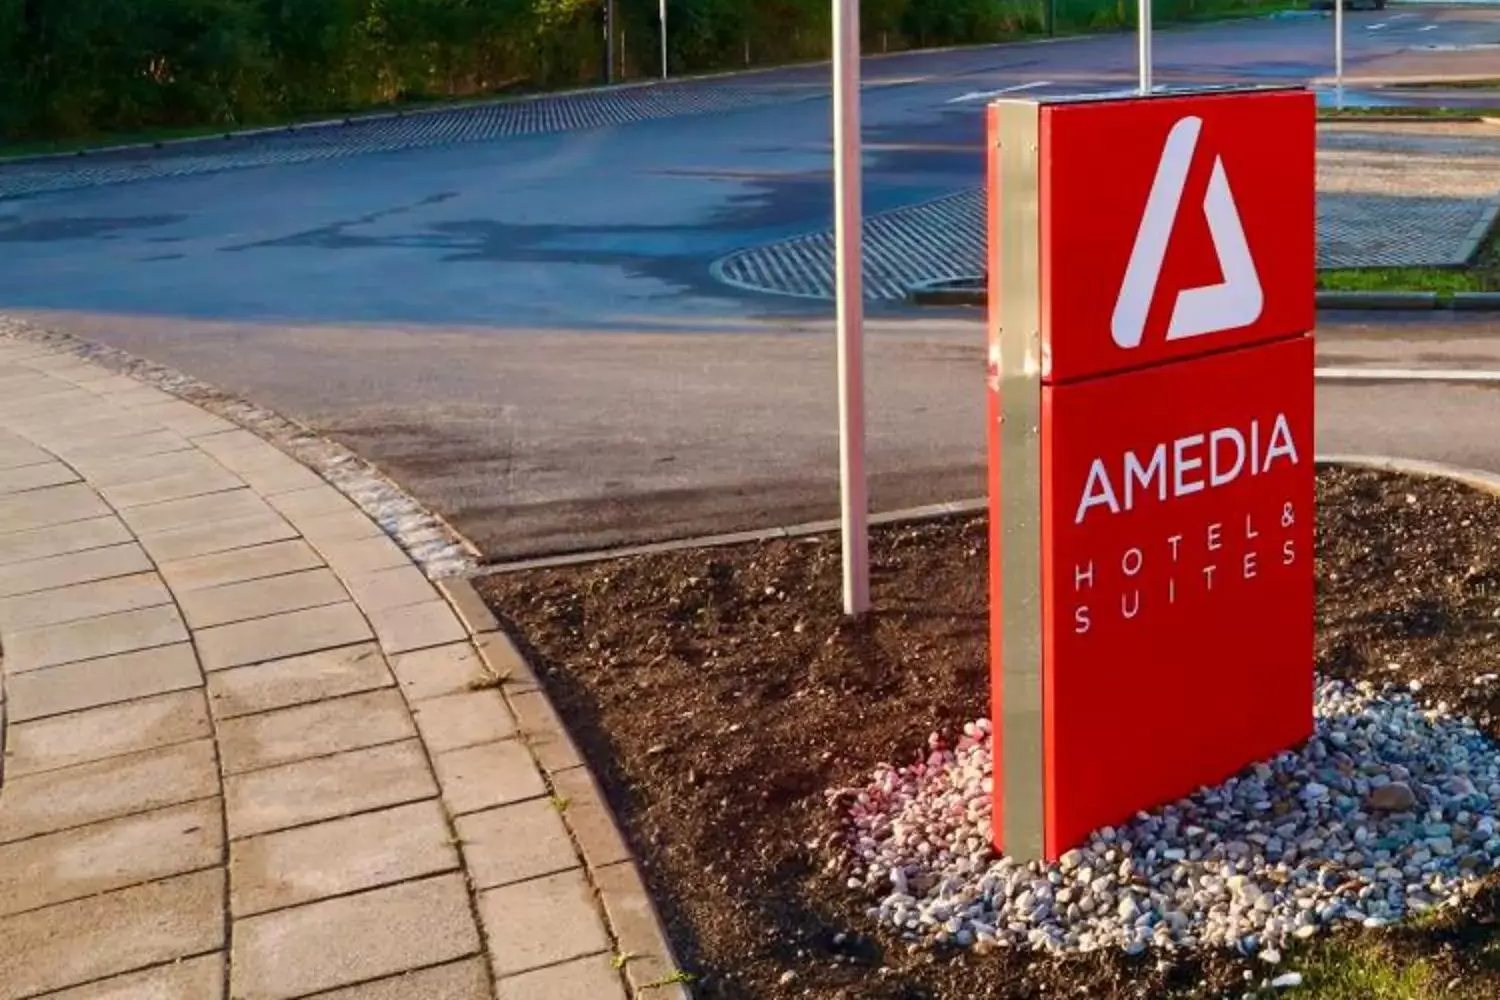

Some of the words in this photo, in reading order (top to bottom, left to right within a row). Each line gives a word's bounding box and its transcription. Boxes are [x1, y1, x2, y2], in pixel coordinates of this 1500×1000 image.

[1075, 413, 1299, 525] AMEDIA
[1075, 513, 1259, 593] HOTEL
[1281, 502, 1294, 527] &
[1075, 539, 1296, 634] SUITES
